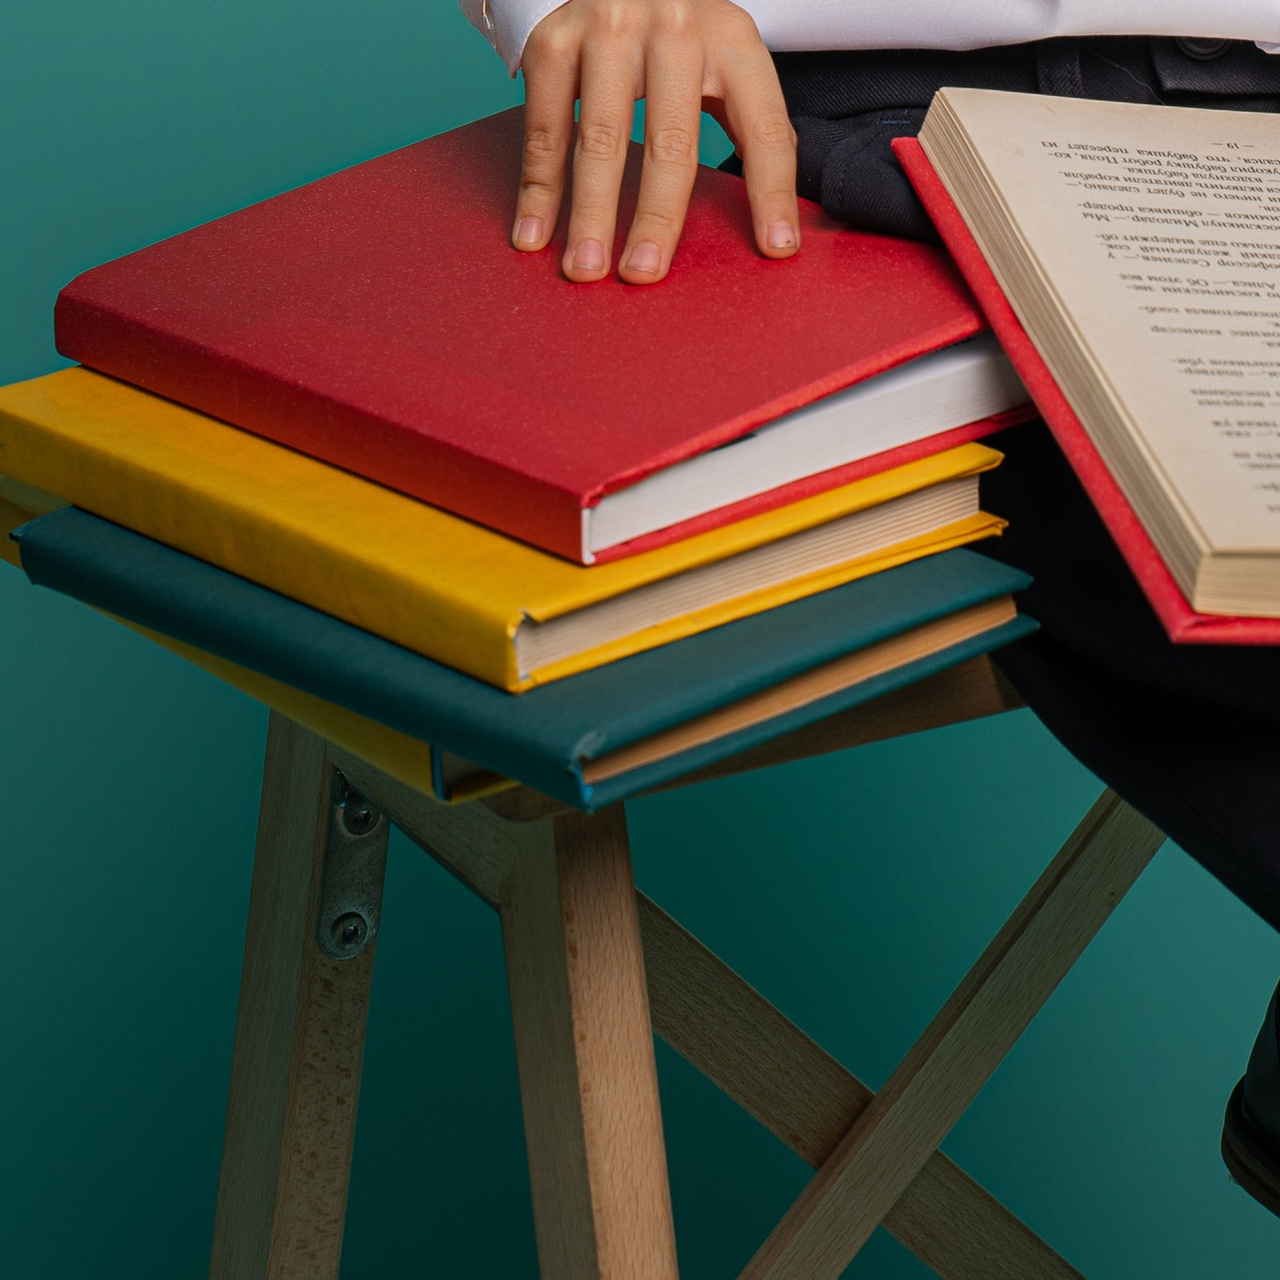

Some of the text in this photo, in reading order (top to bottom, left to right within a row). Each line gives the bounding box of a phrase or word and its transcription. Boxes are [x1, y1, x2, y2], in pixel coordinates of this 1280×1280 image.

[1067, 143, 1129, 154] переедет
[1074, 152, 1119, 164] Поля,
[1136, 149, 1198, 161] бабушка
[1122, 157, 1163, 166] робот
[1167, 160, 1227, 173] бабушку
[1123, 167, 1189, 179] бабушка.
[1229, 166, 1280, 175] укорил
[1059, 171, 1120, 181] корабля.
[1191, 173, 1263, 183] вздохнула
[1123, 176, 1193, 187] двигатели
[1195, 182, 1264, 192] включить
[1147, 188, 1185, 198] будет
[1213, 193, 1262, 202] ничего
[1077, 201, 1134, 212] продер-
[1082, 212, 1110, 222] Мы
[1137, 207, 1203, 217] обшивка
[1123, 235, 1195, 245] выдержит
[1199, 239, 1228, 247] еще
[1108, 251, 1116, 259] у
[1139, 245, 1231, 257] желудочный
[1119, 273, 1143, 281] все
[1147, 275, 1182, 283] этом
[1186, 278, 1209, 286] Об
[1161, 286, 1261, 298] космическим
